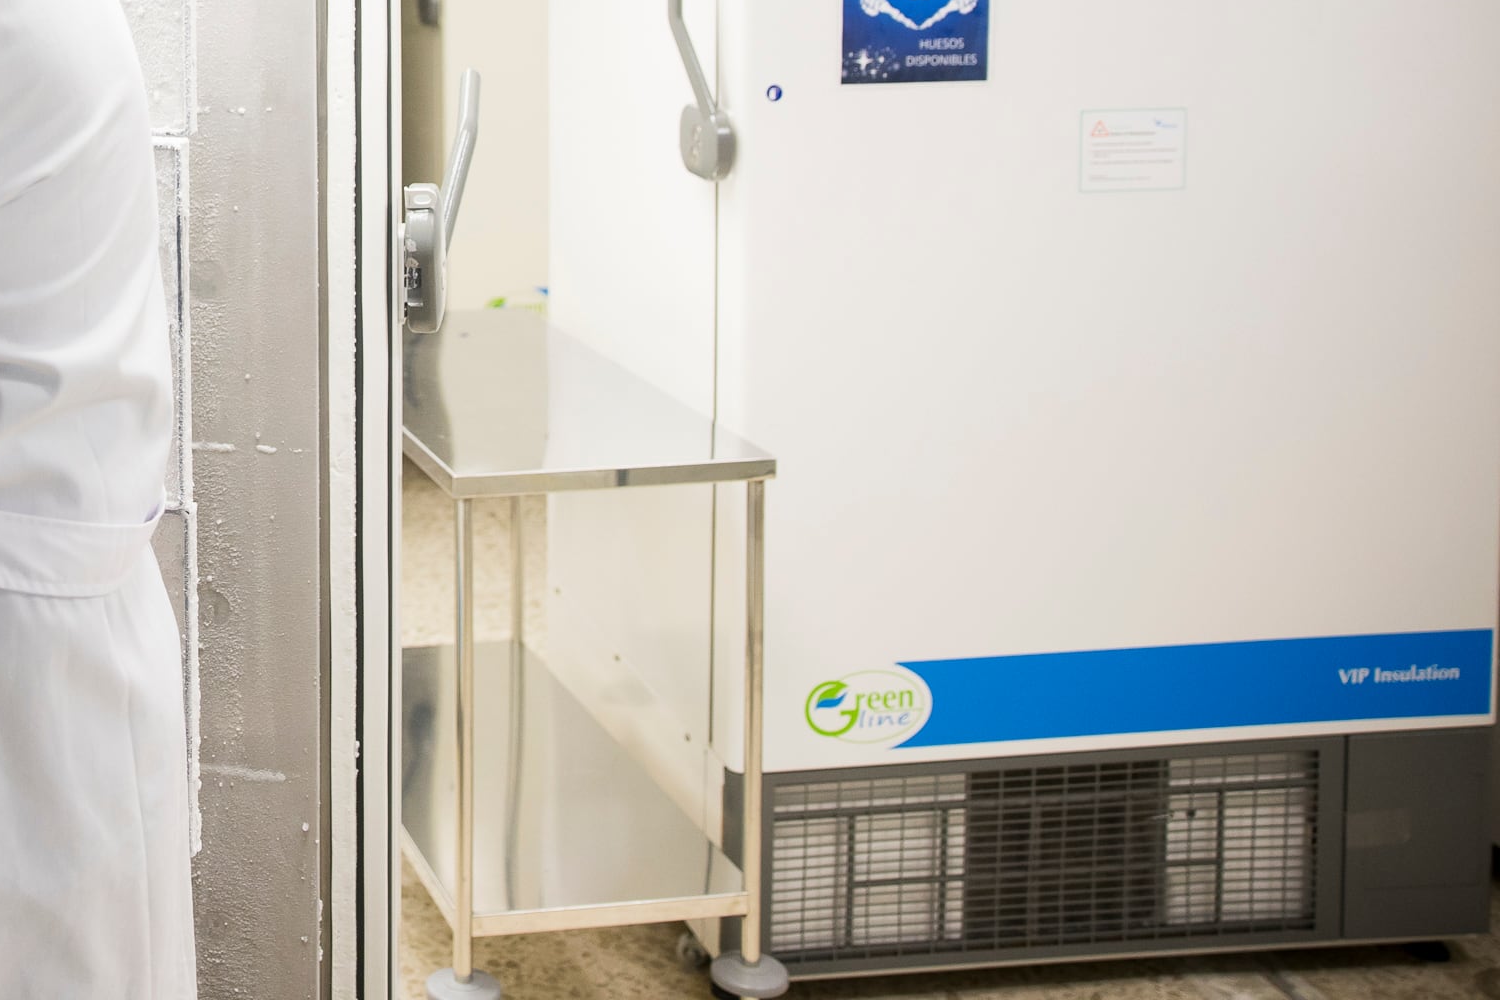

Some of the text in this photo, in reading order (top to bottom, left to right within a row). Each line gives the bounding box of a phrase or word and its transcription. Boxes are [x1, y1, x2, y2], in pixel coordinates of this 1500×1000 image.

[919, 37, 965, 50] HUESOS
[905, 53, 978, 67] DISPONIBLES
[1338, 664, 1461, 685] VIP Insulation
[805, 680, 914, 737] Green
[859, 710, 911, 729] line
